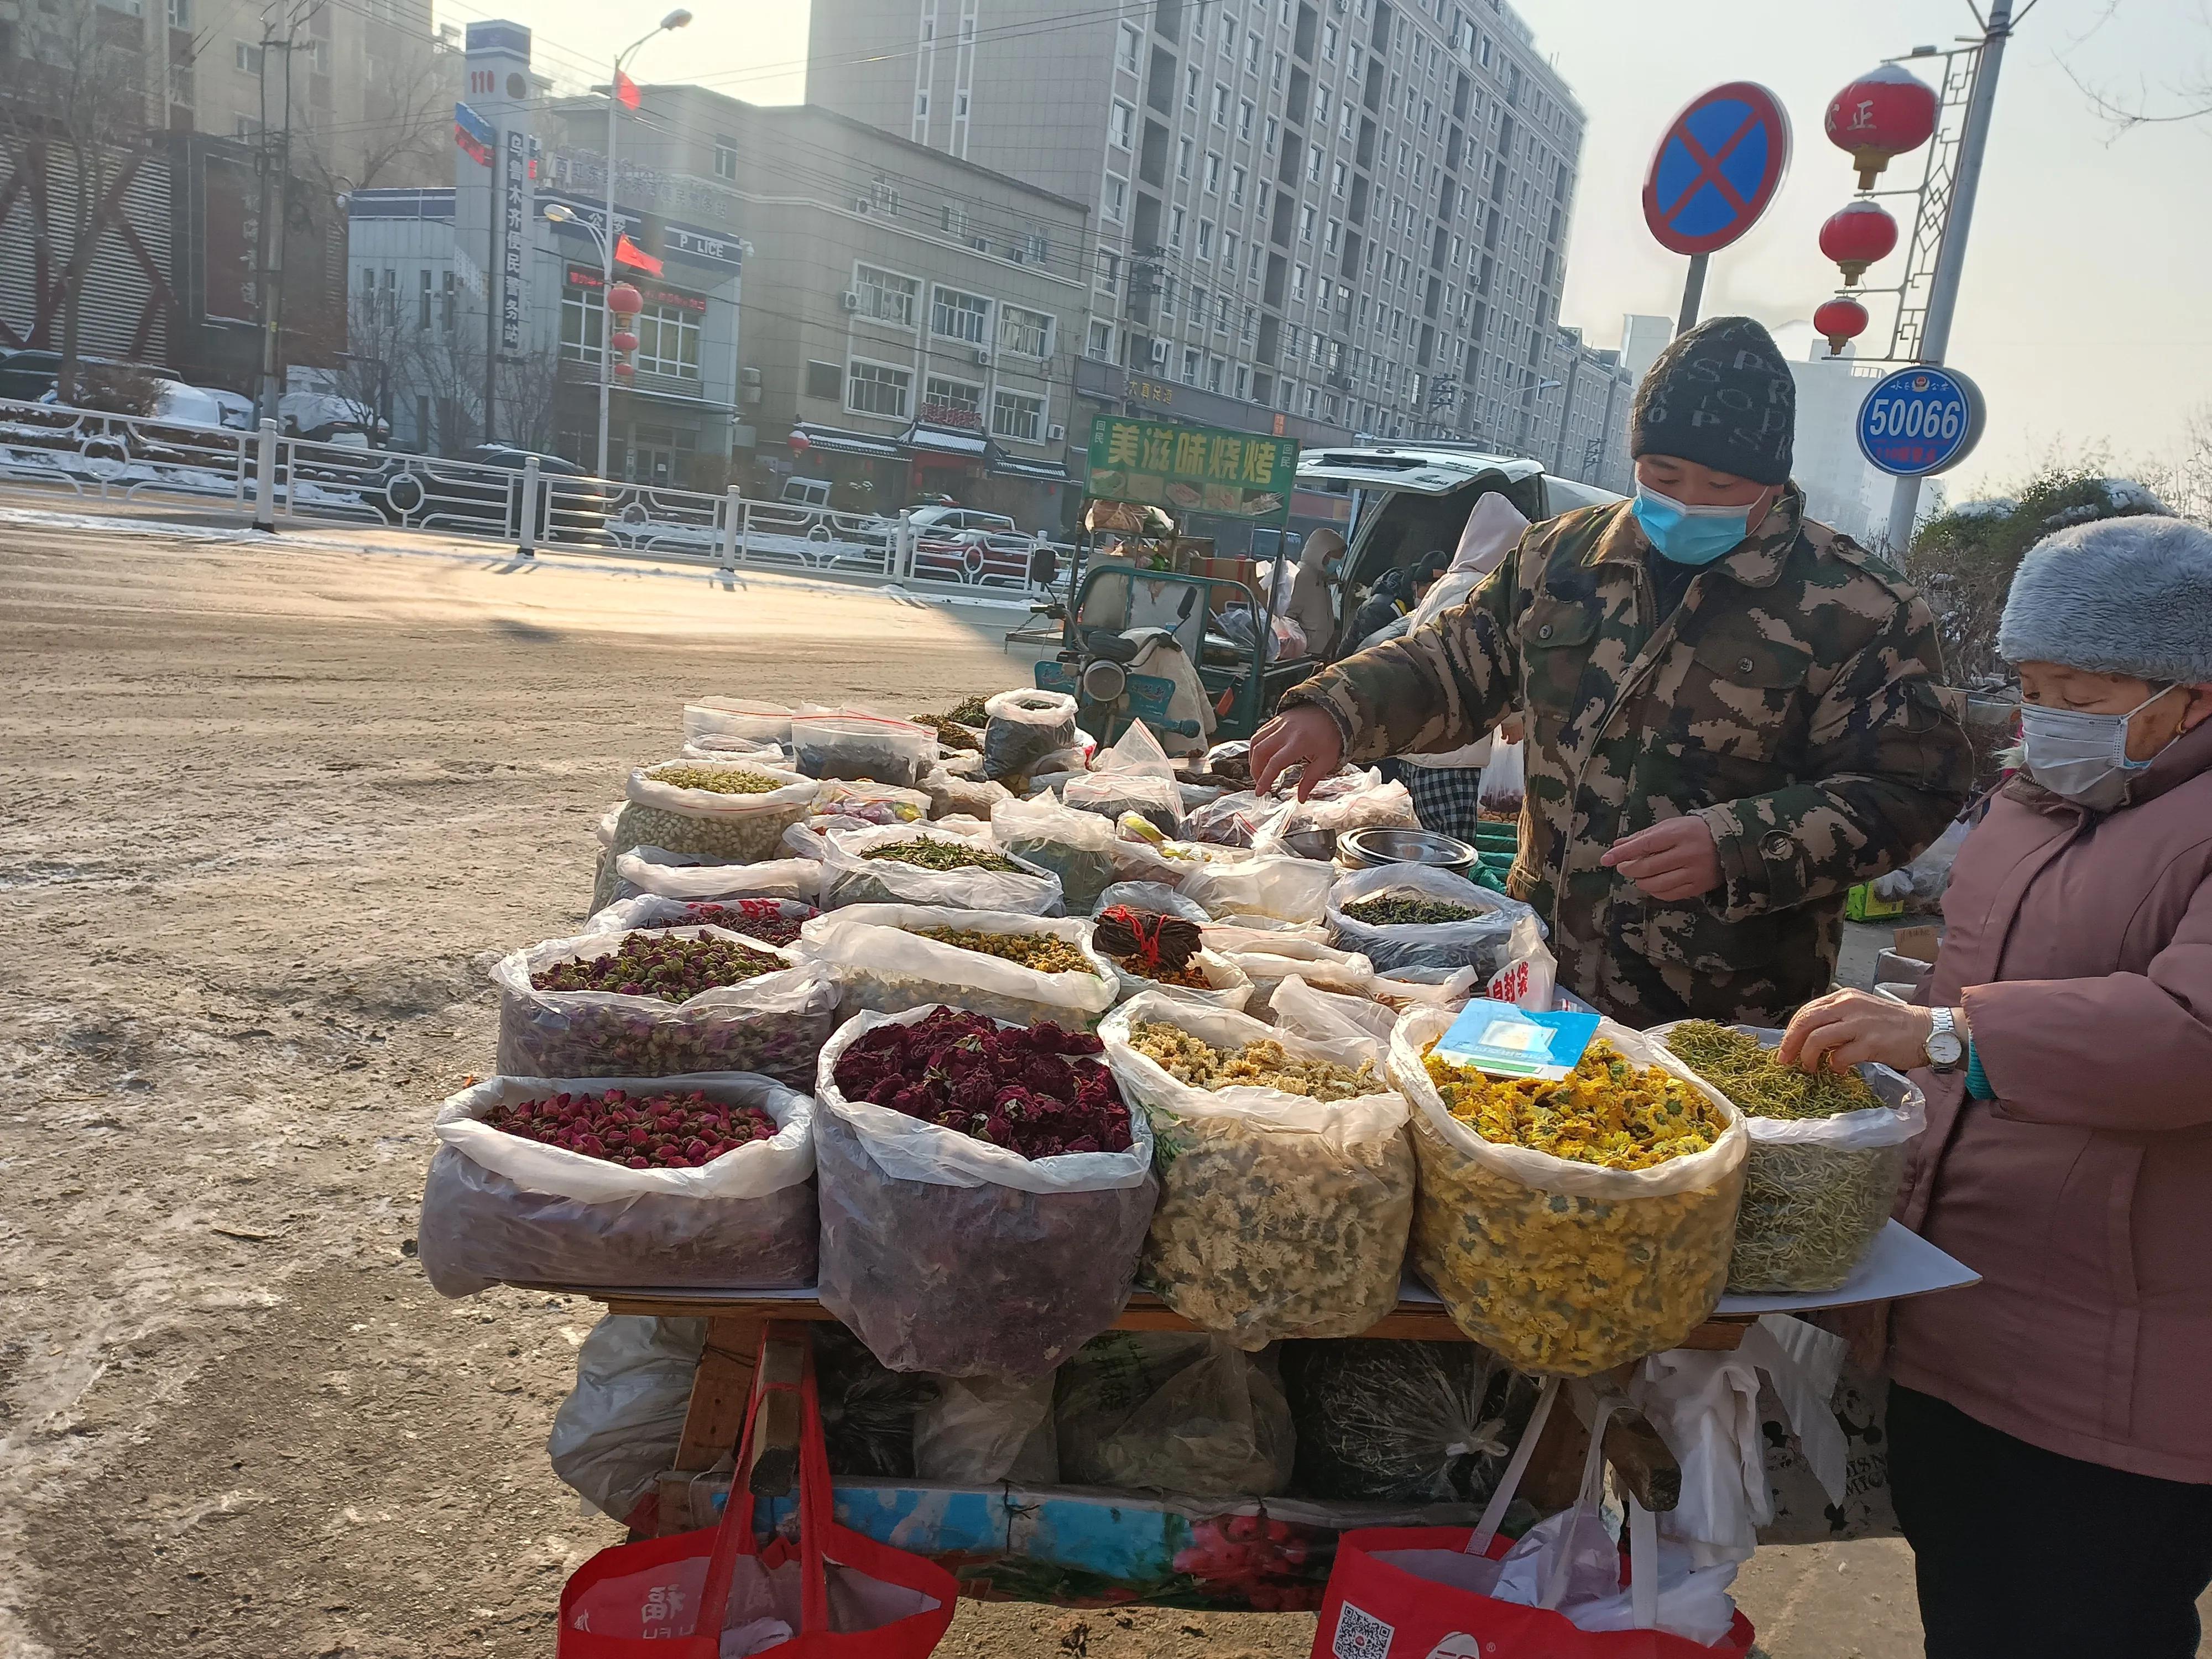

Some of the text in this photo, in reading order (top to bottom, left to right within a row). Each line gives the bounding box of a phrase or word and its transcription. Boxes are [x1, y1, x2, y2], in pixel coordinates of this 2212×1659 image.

[471, 70, 494, 93] 110
[504, 134, 523, 343] 乌鲁木齐便民警务站
[588, 213, 626, 232] 公安
[1870, 399, 1960, 439] 50066
[1094, 420, 1106, 444] 回民
[1108, 423, 1276, 484] 美滋味烧烤
[1281, 445, 1293, 468] 回民
[1486, 961, 1528, 1002] 自封袋
